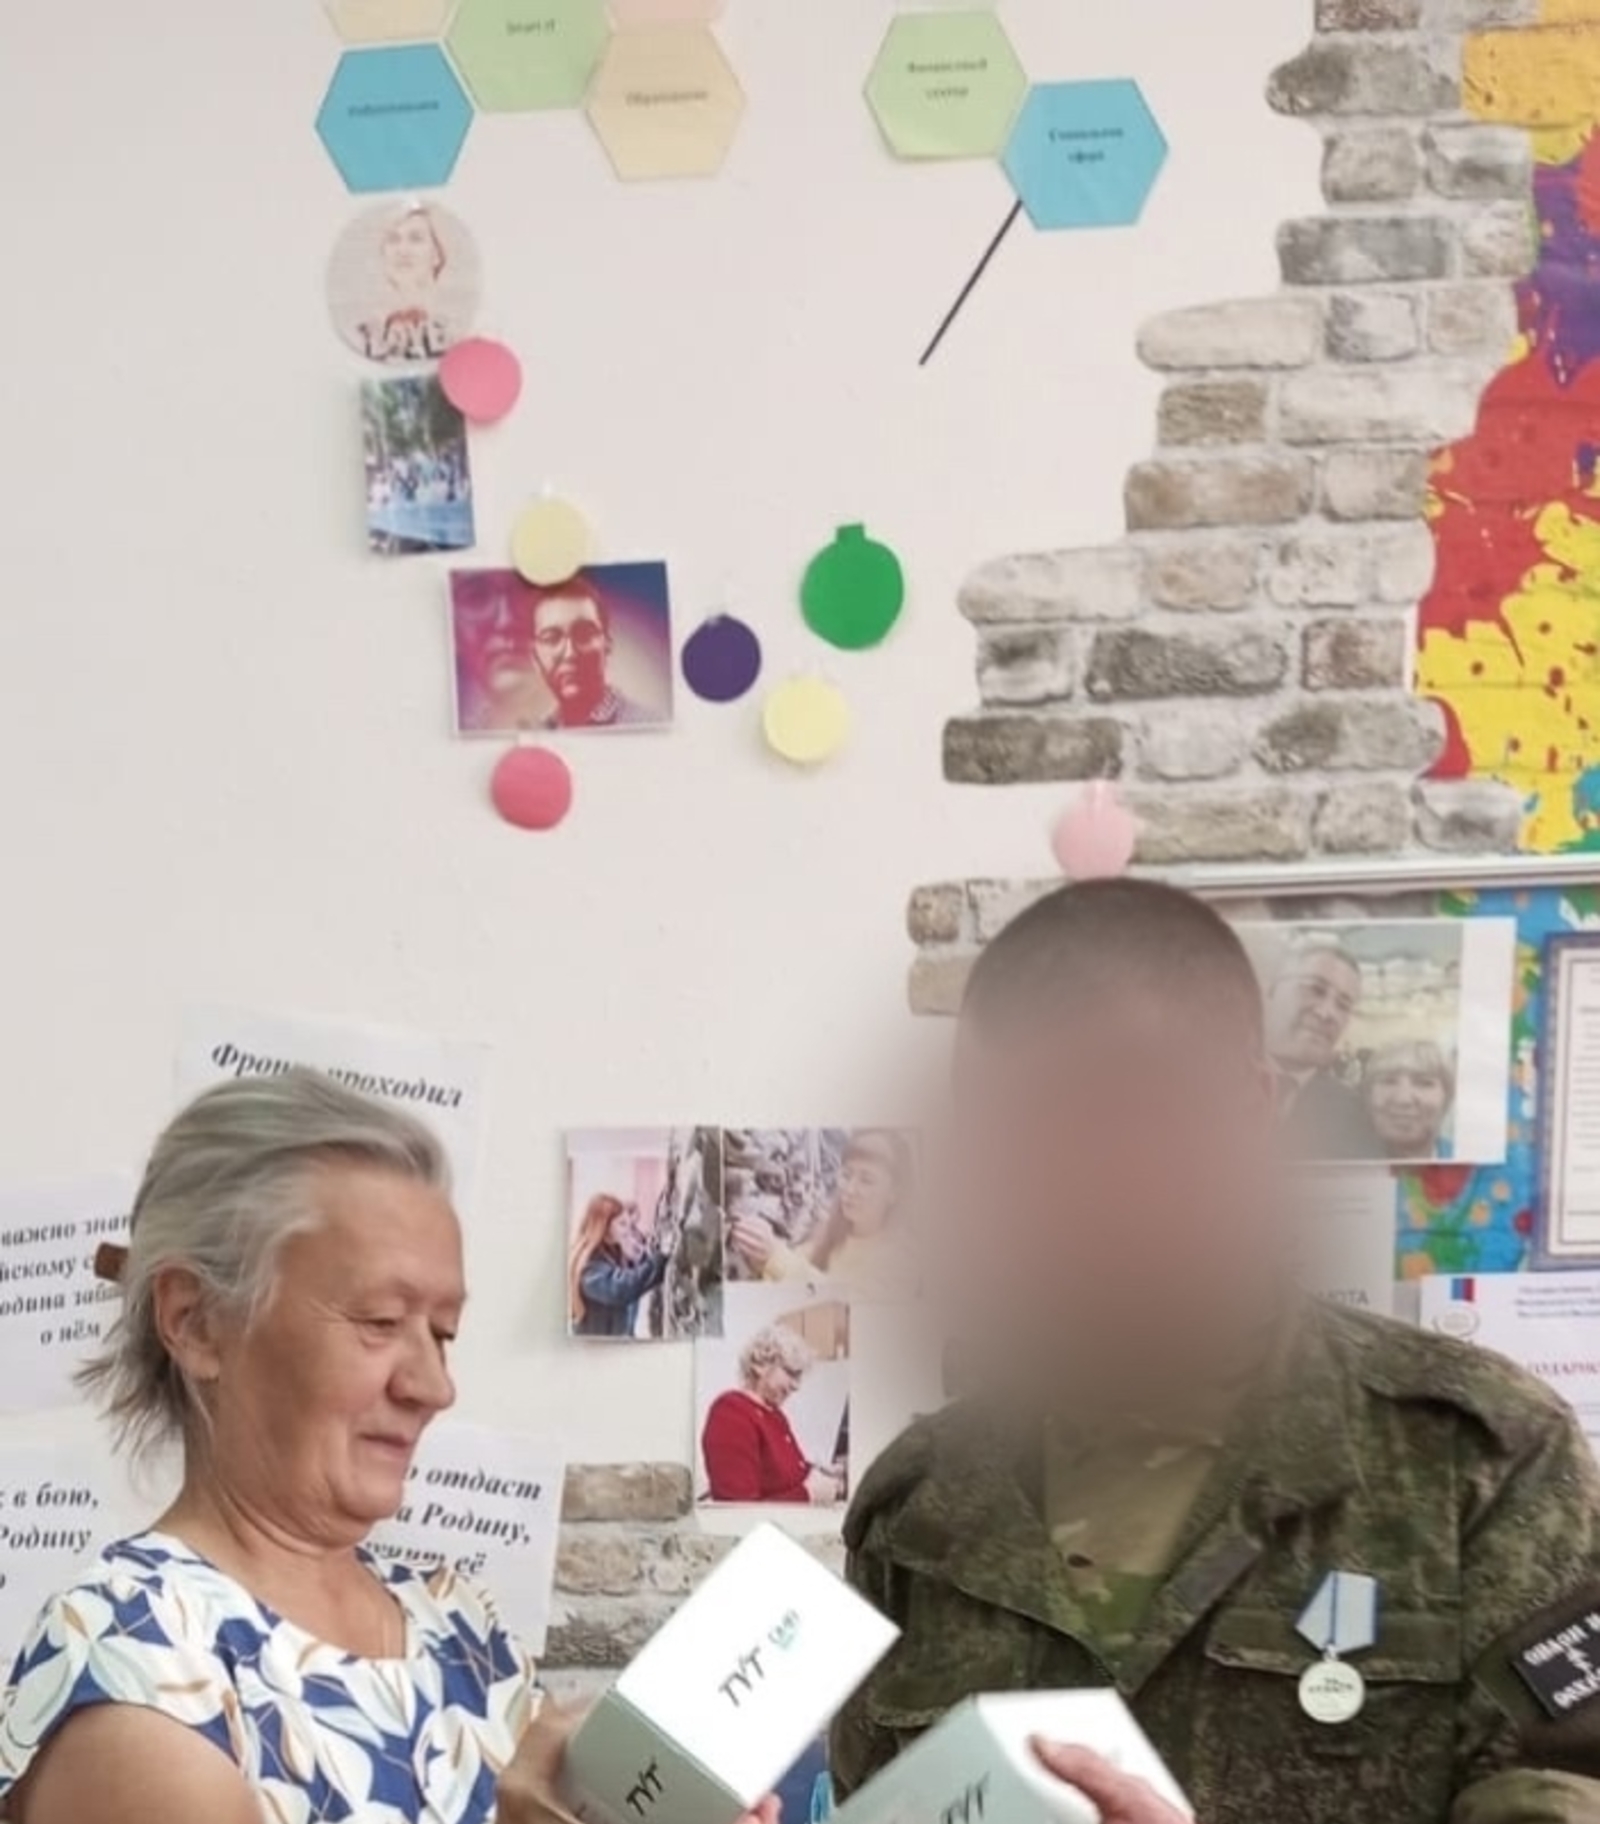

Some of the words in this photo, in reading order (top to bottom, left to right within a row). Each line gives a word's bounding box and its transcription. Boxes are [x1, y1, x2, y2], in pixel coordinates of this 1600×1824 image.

[211, 1043, 290, 1078] Фрон
[13, 1490, 27, 1507] в
[36, 1482, 98, 1508] бою,
[425, 1466, 541, 1500] отдаст
[421, 1502, 530, 1546] Родину,
[454, 1552, 487, 1574] её
[718, 1644, 764, 1708] TYT
[625, 1759, 663, 1816] TYT
